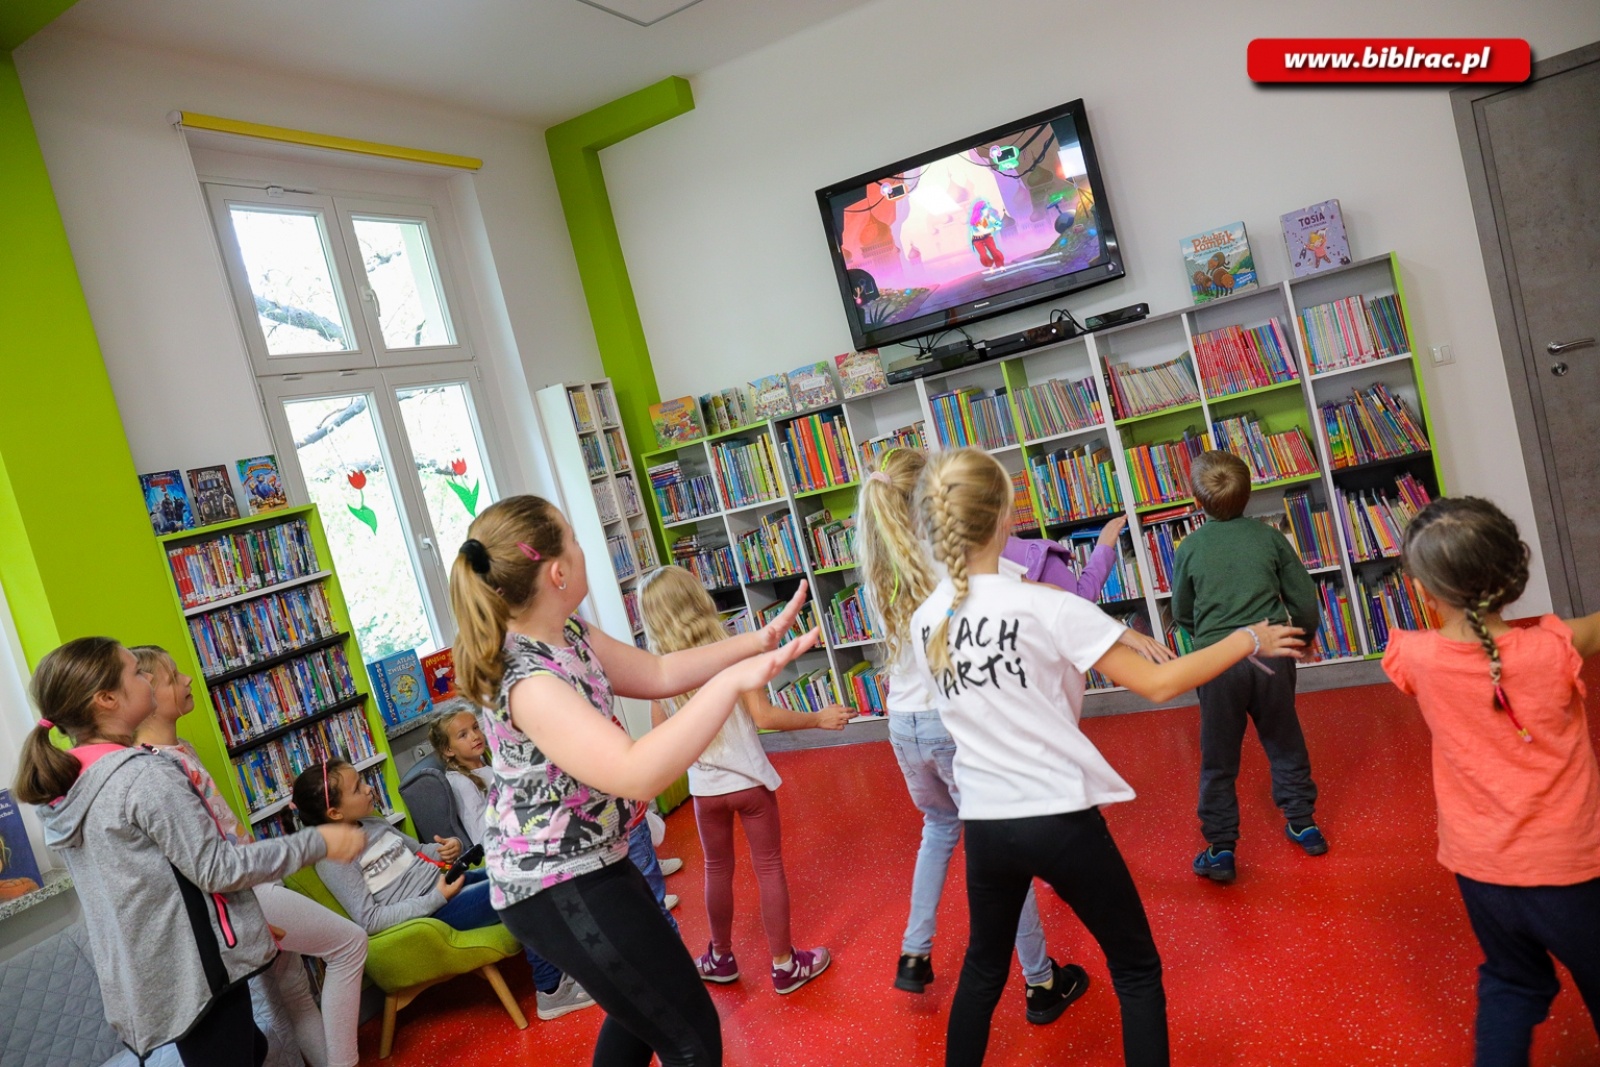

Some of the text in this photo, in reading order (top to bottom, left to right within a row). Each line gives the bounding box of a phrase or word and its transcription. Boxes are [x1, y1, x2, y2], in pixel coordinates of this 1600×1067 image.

[1191, 230, 1235, 253] Pompik
[922, 616, 1019, 654] BACH
[397, 653, 416, 665] ATLAS
[426, 654, 447, 668] Mysia
[800, 965, 811, 977] N
